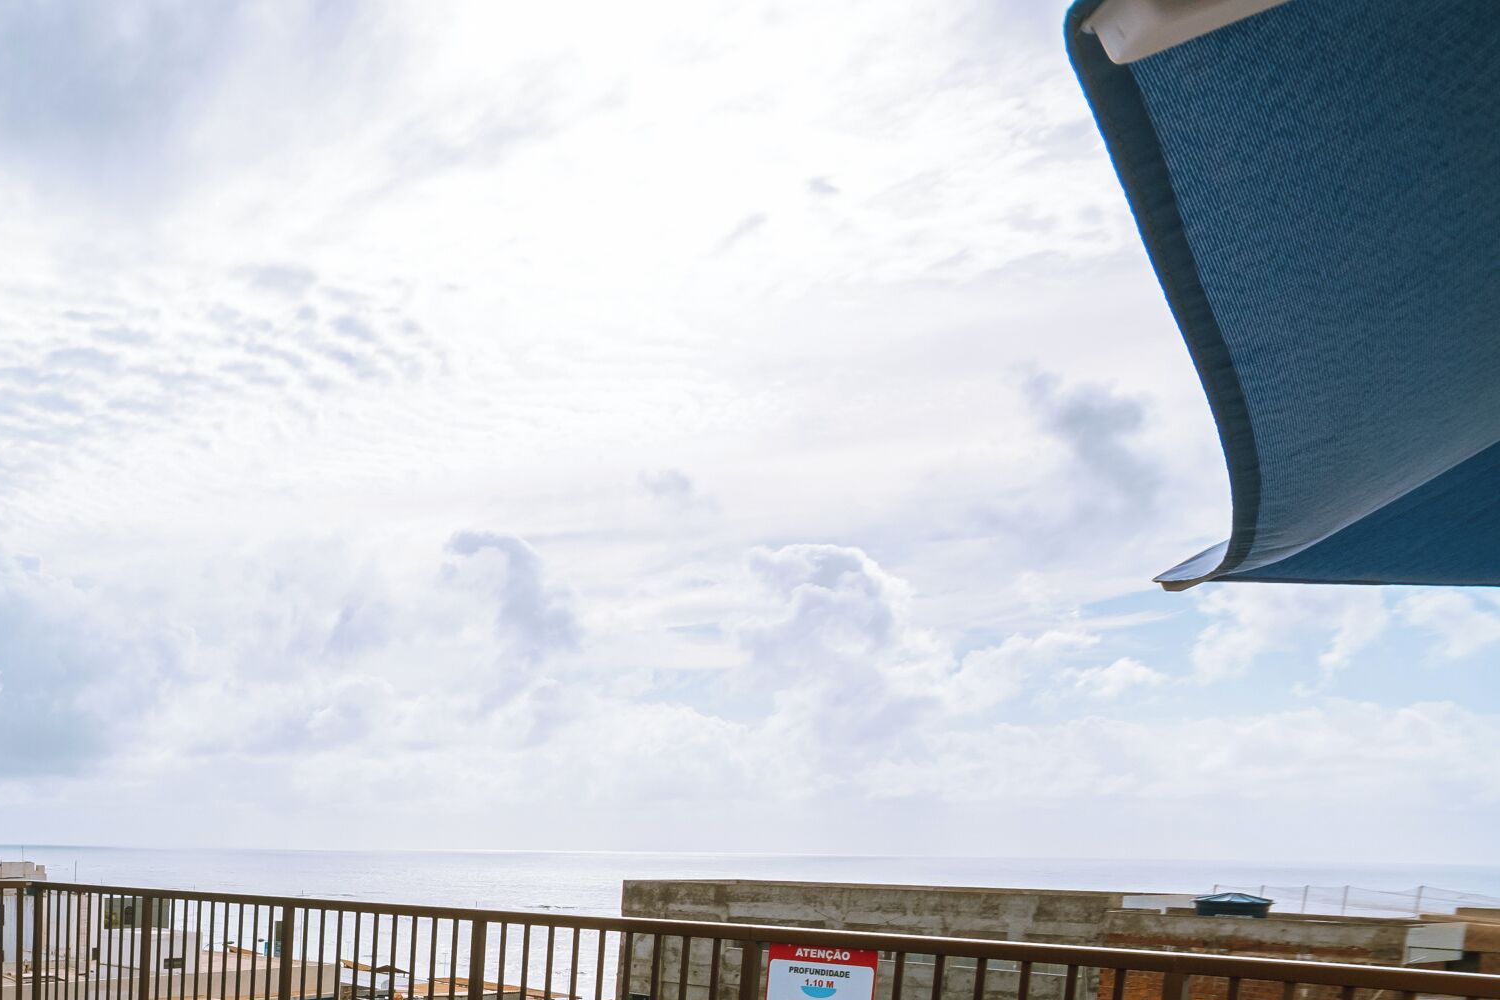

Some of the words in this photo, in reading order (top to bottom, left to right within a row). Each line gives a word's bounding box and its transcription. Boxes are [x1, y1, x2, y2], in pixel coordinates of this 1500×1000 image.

[795, 948, 850, 961] ATENÇÃO
[788, 966, 850, 978] PROFUNDIDADE
[805, 979, 823, 987] 1.10
